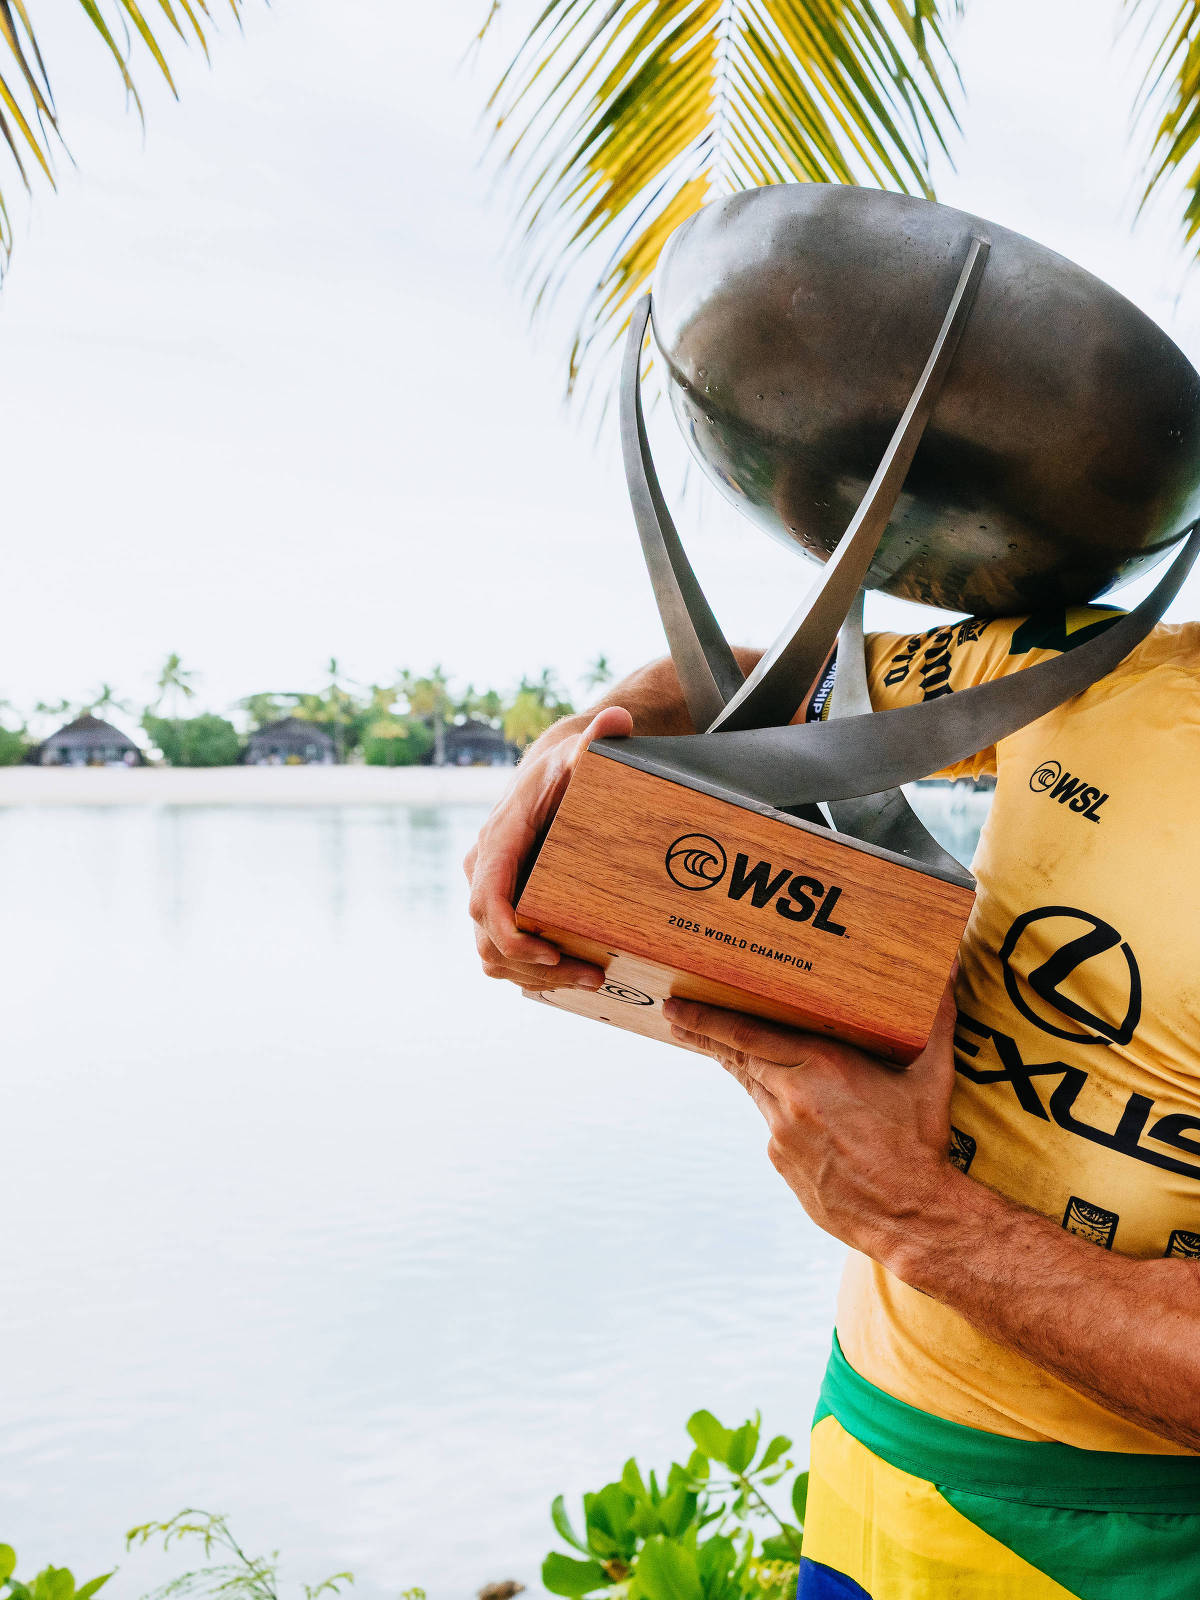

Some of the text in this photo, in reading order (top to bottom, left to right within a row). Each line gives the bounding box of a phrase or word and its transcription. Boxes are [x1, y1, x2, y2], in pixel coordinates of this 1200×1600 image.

[1049, 772, 1109, 822] WSL
[728, 852, 847, 937] WSL
[668, 915, 813, 972] 2025 WORLD CHAMPION
